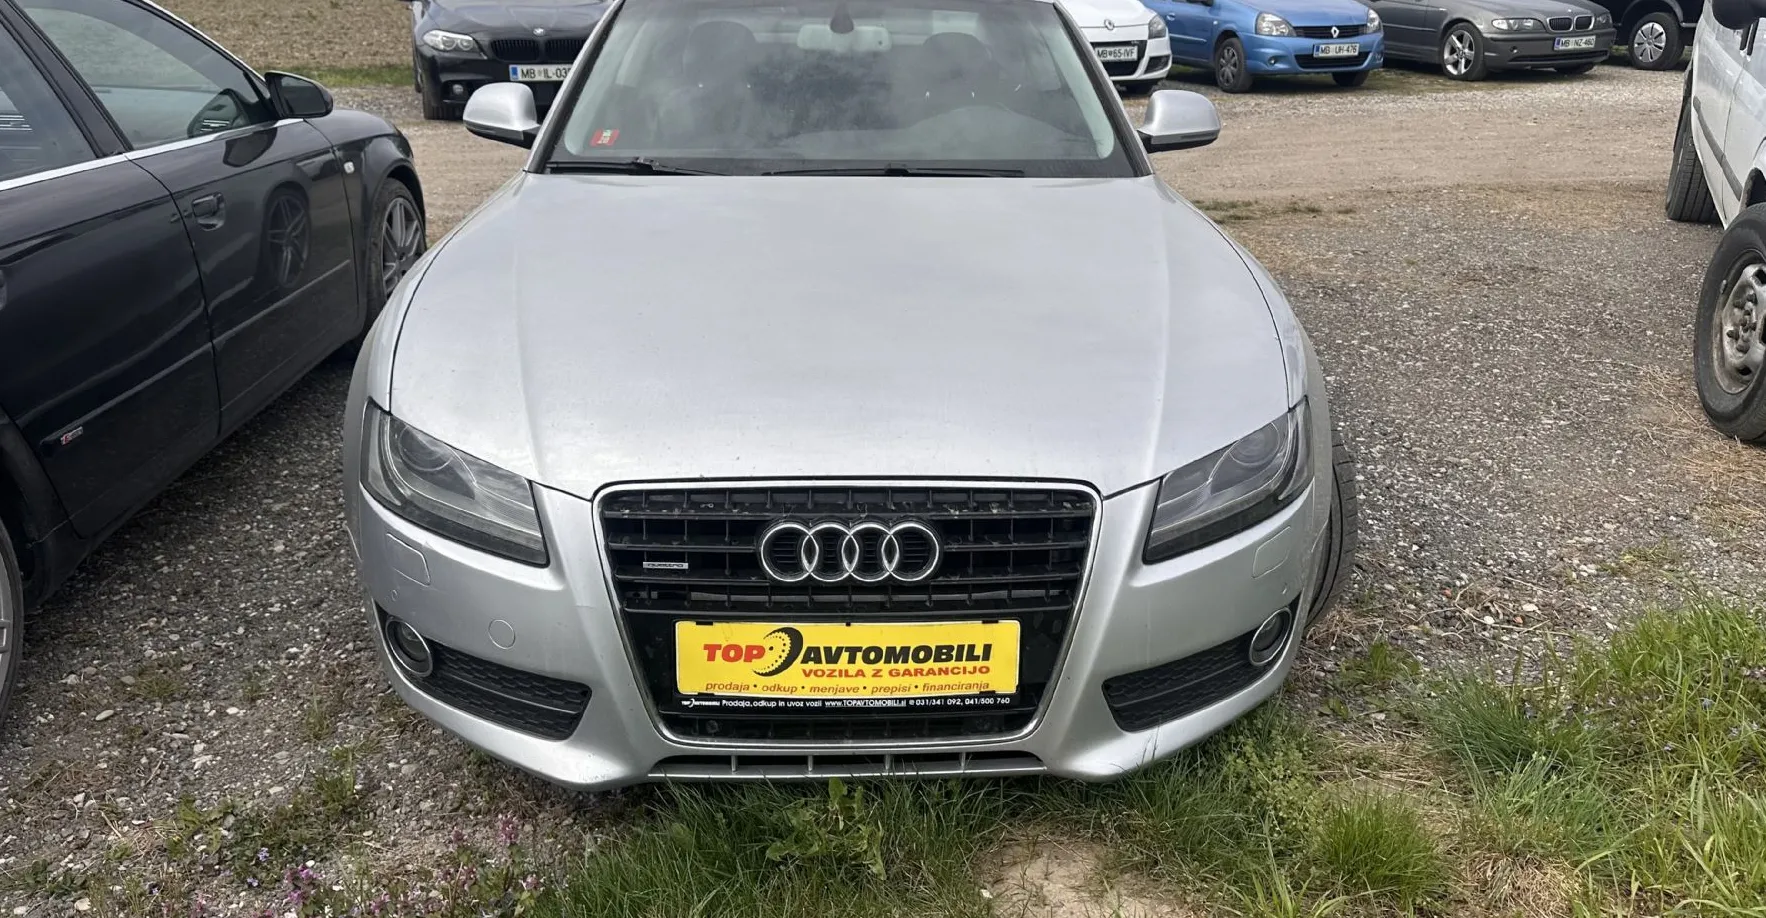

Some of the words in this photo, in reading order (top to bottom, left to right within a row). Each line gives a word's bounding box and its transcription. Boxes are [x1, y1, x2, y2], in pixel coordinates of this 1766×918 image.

[1561, 39, 1571, 48] MB
[1320, 45, 1330, 55] MB
[521, 68, 536, 79] MB
[703, 643, 765, 663] TOP
[800, 643, 992, 665] AVTOMOBILI
[802, 668, 866, 679] VOZILA
[871, 668, 884, 678] Z
[888, 665, 990, 678] GARANCIJO
[705, 682, 750, 692] prodaja
[762, 683, 798, 694] odkup
[809, 685, 860, 694] menjave
[871, 683, 911, 695] prepisi
[922, 681, 990, 692] financiranja
